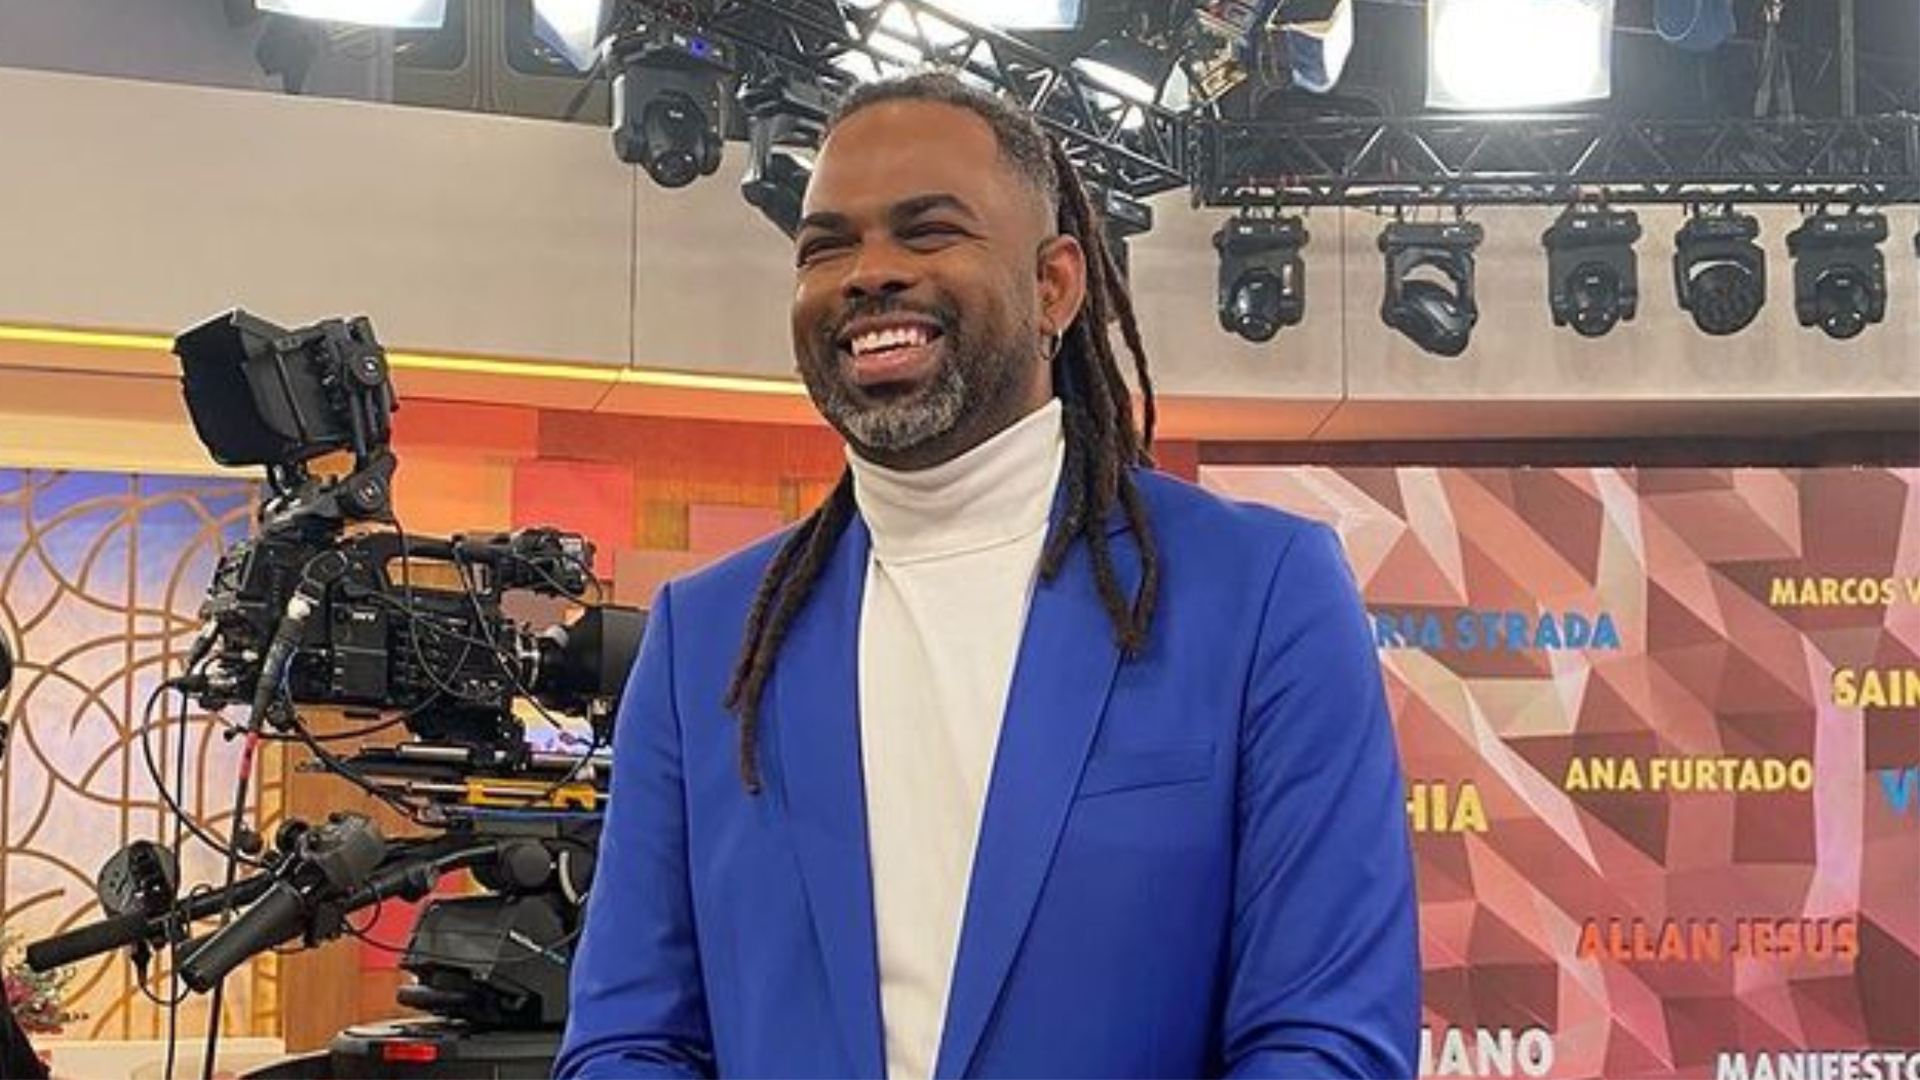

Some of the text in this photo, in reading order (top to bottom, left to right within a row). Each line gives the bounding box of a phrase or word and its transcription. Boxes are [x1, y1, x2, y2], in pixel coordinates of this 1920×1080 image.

[1768, 577, 1895, 607] MARCOS
[1455, 609, 1621, 651] STRADA
[1564, 756, 1814, 792] ANA FURTADO
[1577, 917, 1859, 962] ALLAN JESUS
